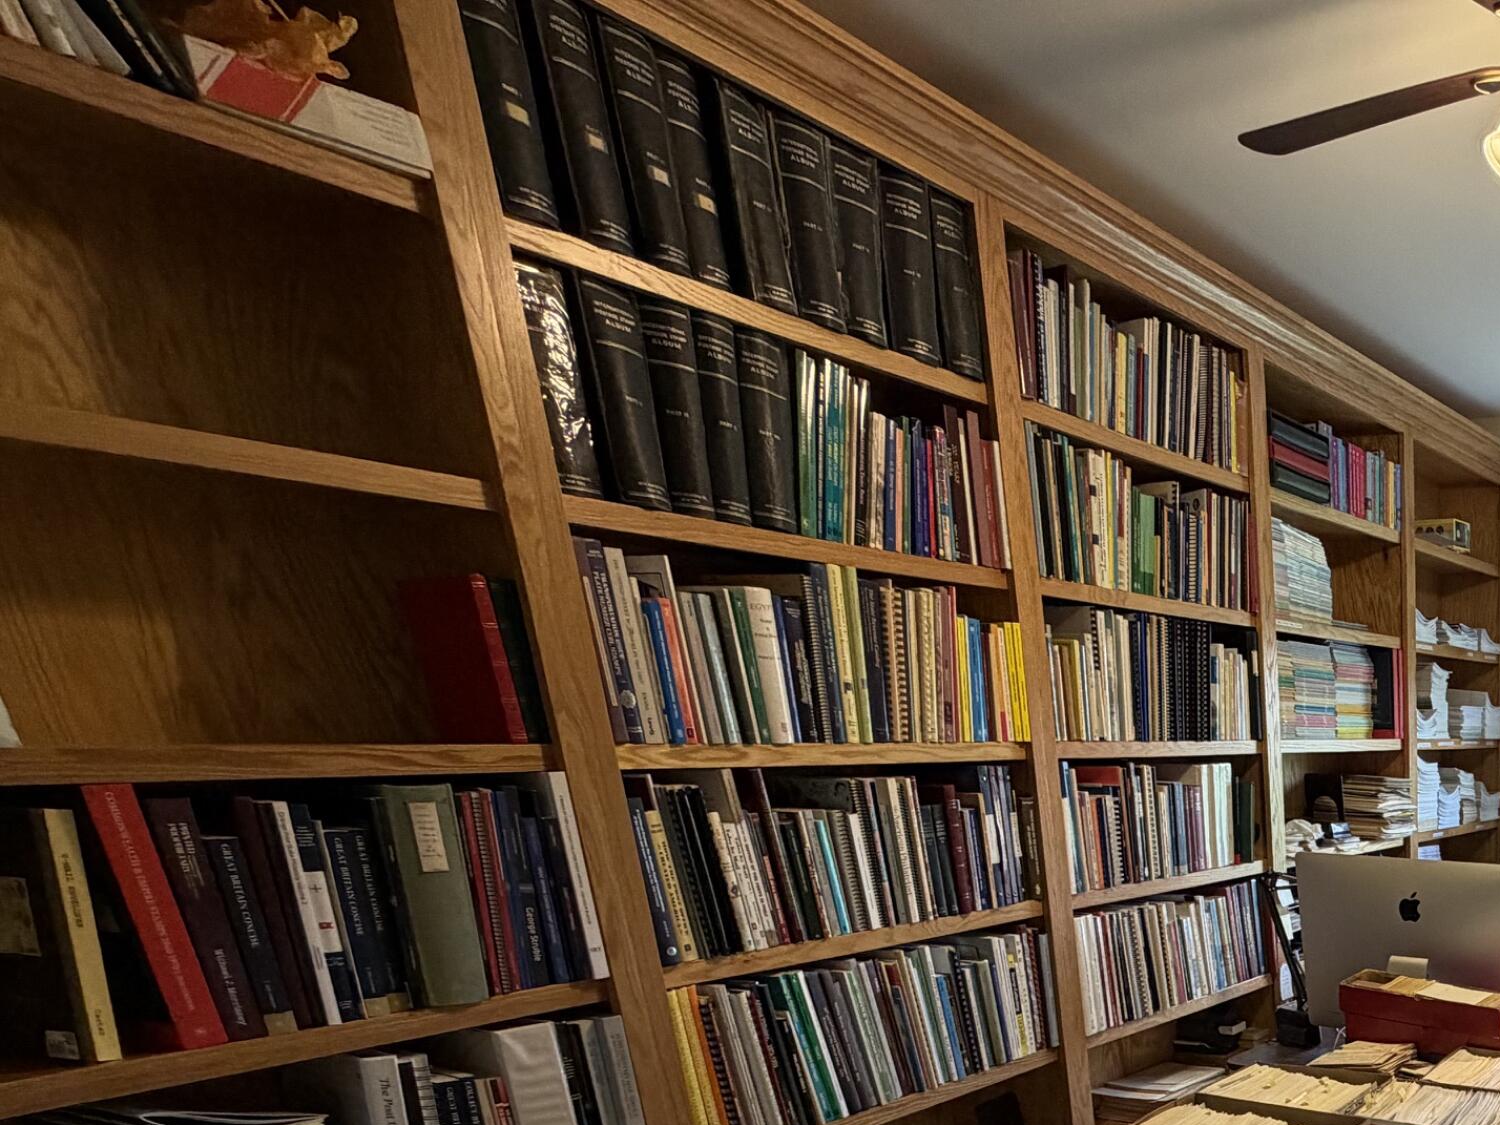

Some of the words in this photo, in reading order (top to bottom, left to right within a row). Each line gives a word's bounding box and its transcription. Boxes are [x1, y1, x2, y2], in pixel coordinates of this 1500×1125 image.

[217, 840, 238, 874] GREAT
[330, 835, 349, 866] GREAT
[226, 872, 251, 911] BRITAIN
[337, 864, 358, 902] BRITAIN
[354, 833, 369, 862] GREAT
[368, 896, 385, 932] CONCISE
[238, 909, 262, 949] CONCISE
[346, 900, 367, 937] CONCISE
[521, 905, 540, 935] George
[377, 1077, 392, 1097] The
[380, 1097, 396, 1120] Post
